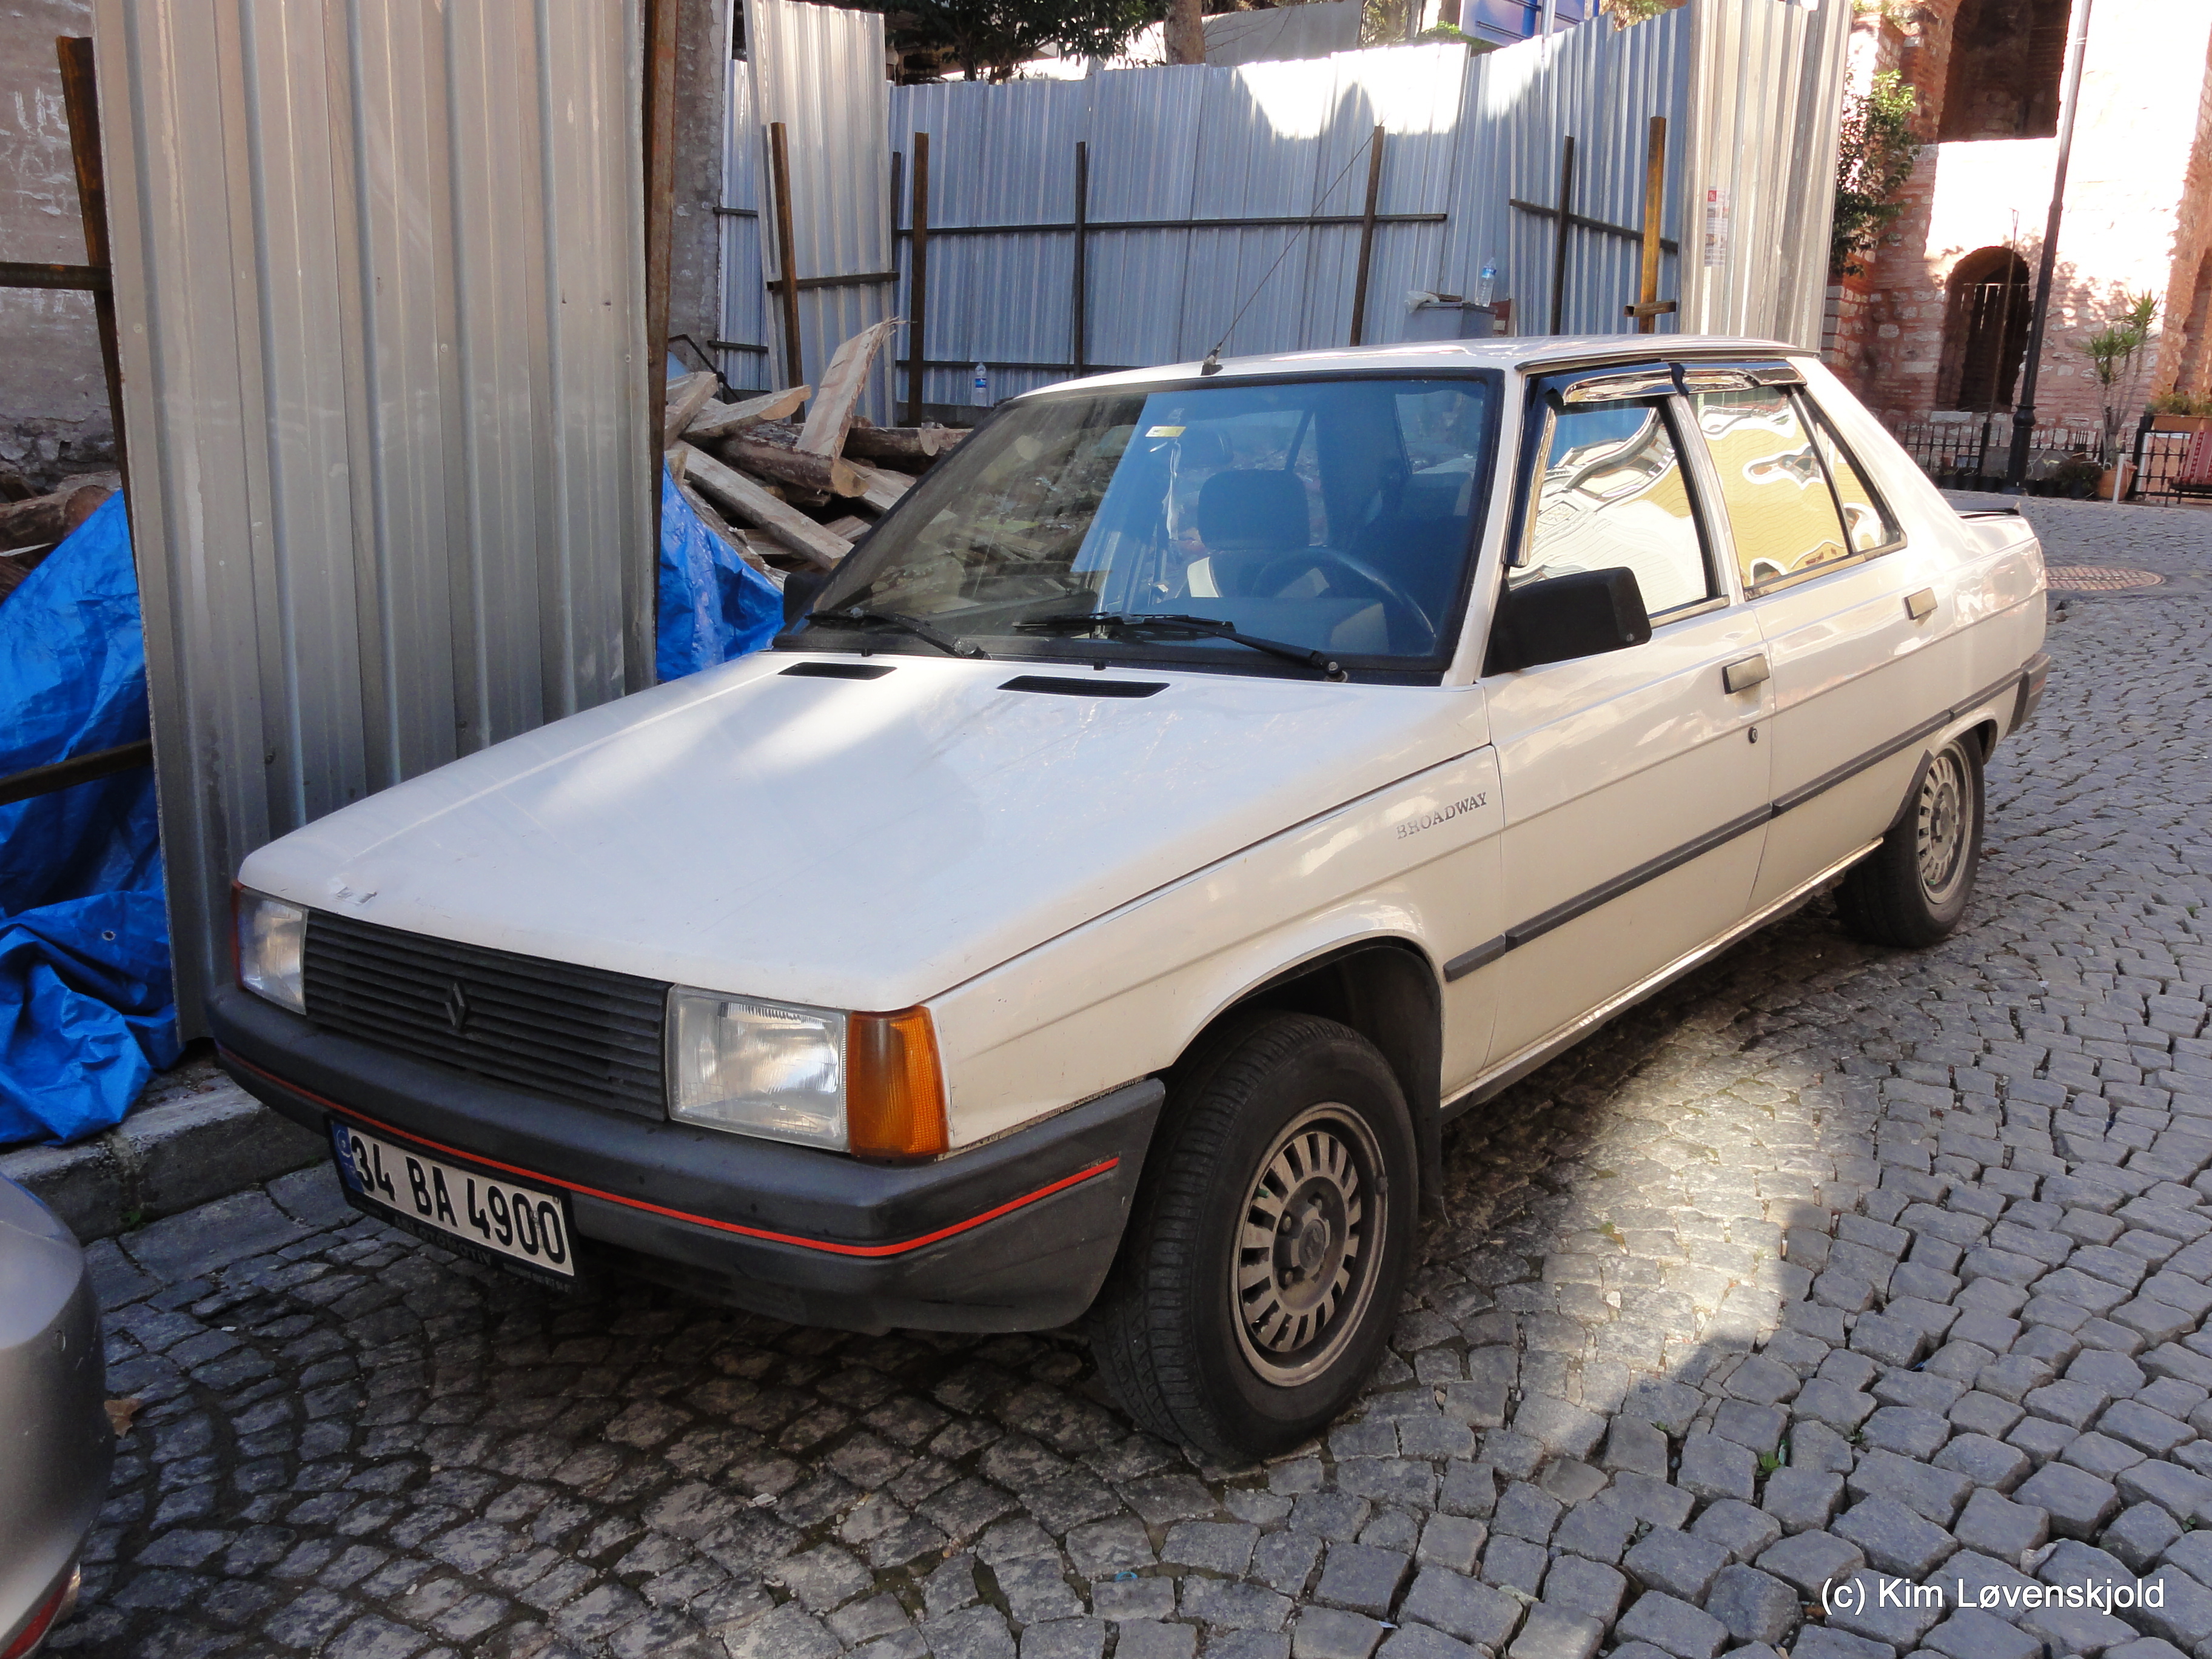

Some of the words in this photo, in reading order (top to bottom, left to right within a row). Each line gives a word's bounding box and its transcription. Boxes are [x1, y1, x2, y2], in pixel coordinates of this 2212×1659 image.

[1396, 792, 1487, 840] BROADWAY
[351, 1135, 396, 1202] 34
[406, 1156, 459, 1228] BA
[467, 1178, 567, 1265] 4900
